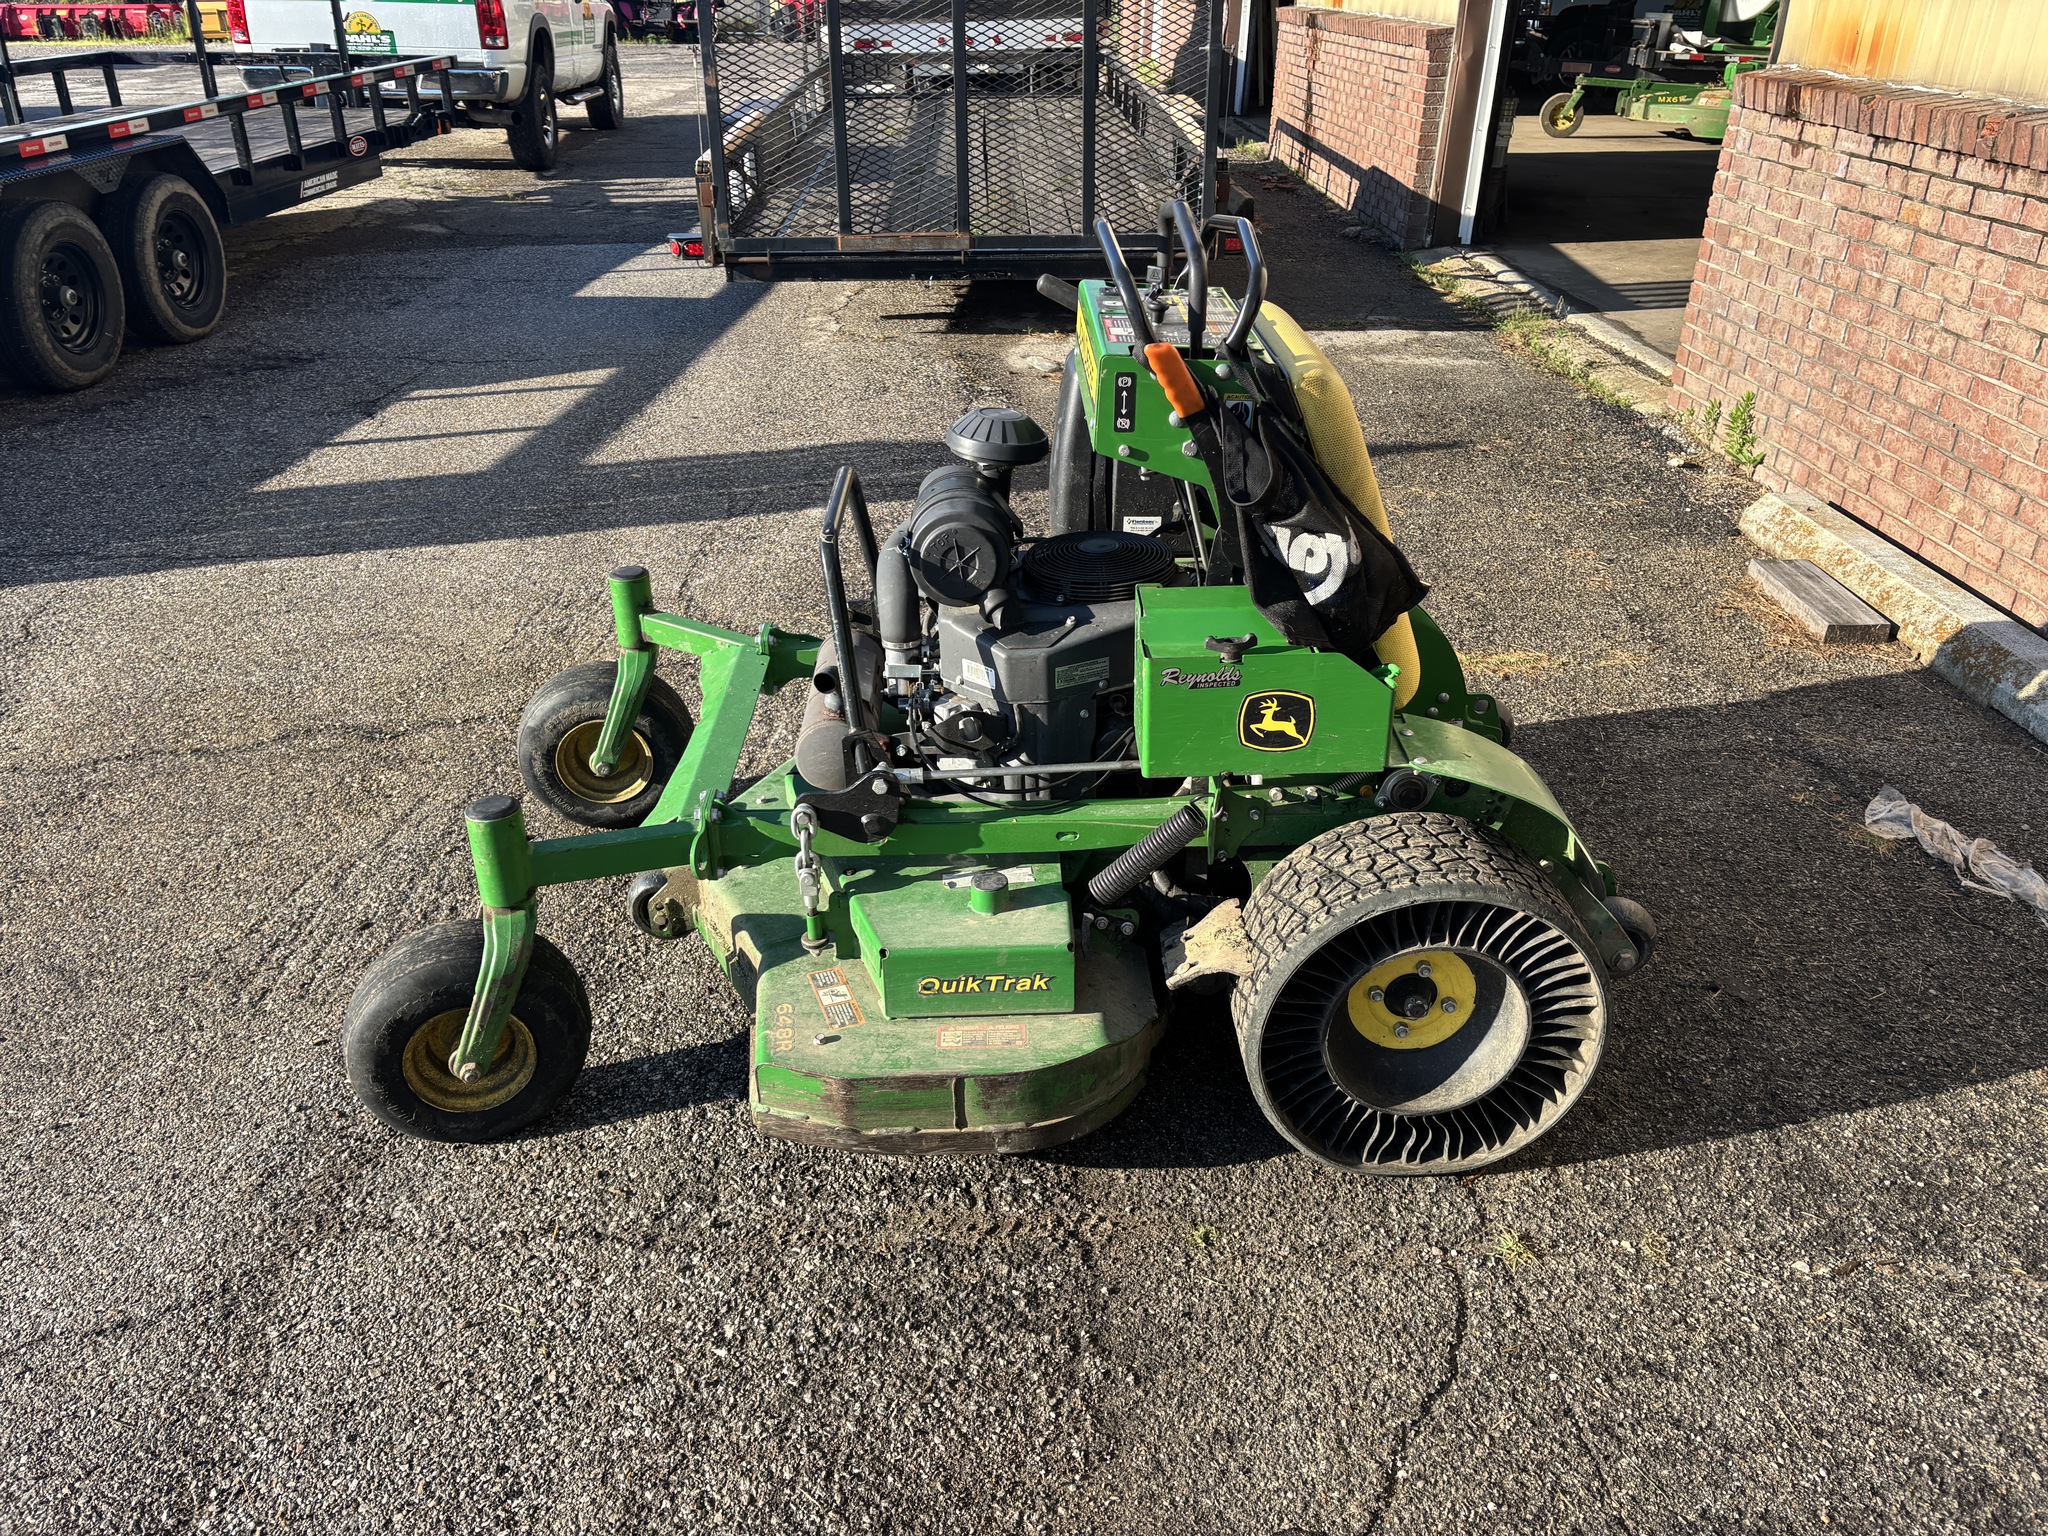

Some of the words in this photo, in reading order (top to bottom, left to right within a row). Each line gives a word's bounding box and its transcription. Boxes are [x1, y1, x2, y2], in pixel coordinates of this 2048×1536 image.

[930, 533, 949, 551] TOP
[1160, 665, 1242, 690] Reynolds
[1196, 680, 1236, 689] INSPECTED
[918, 973, 1054, 996] QuikTrak
[774, 1002, 795, 1053] 648R
